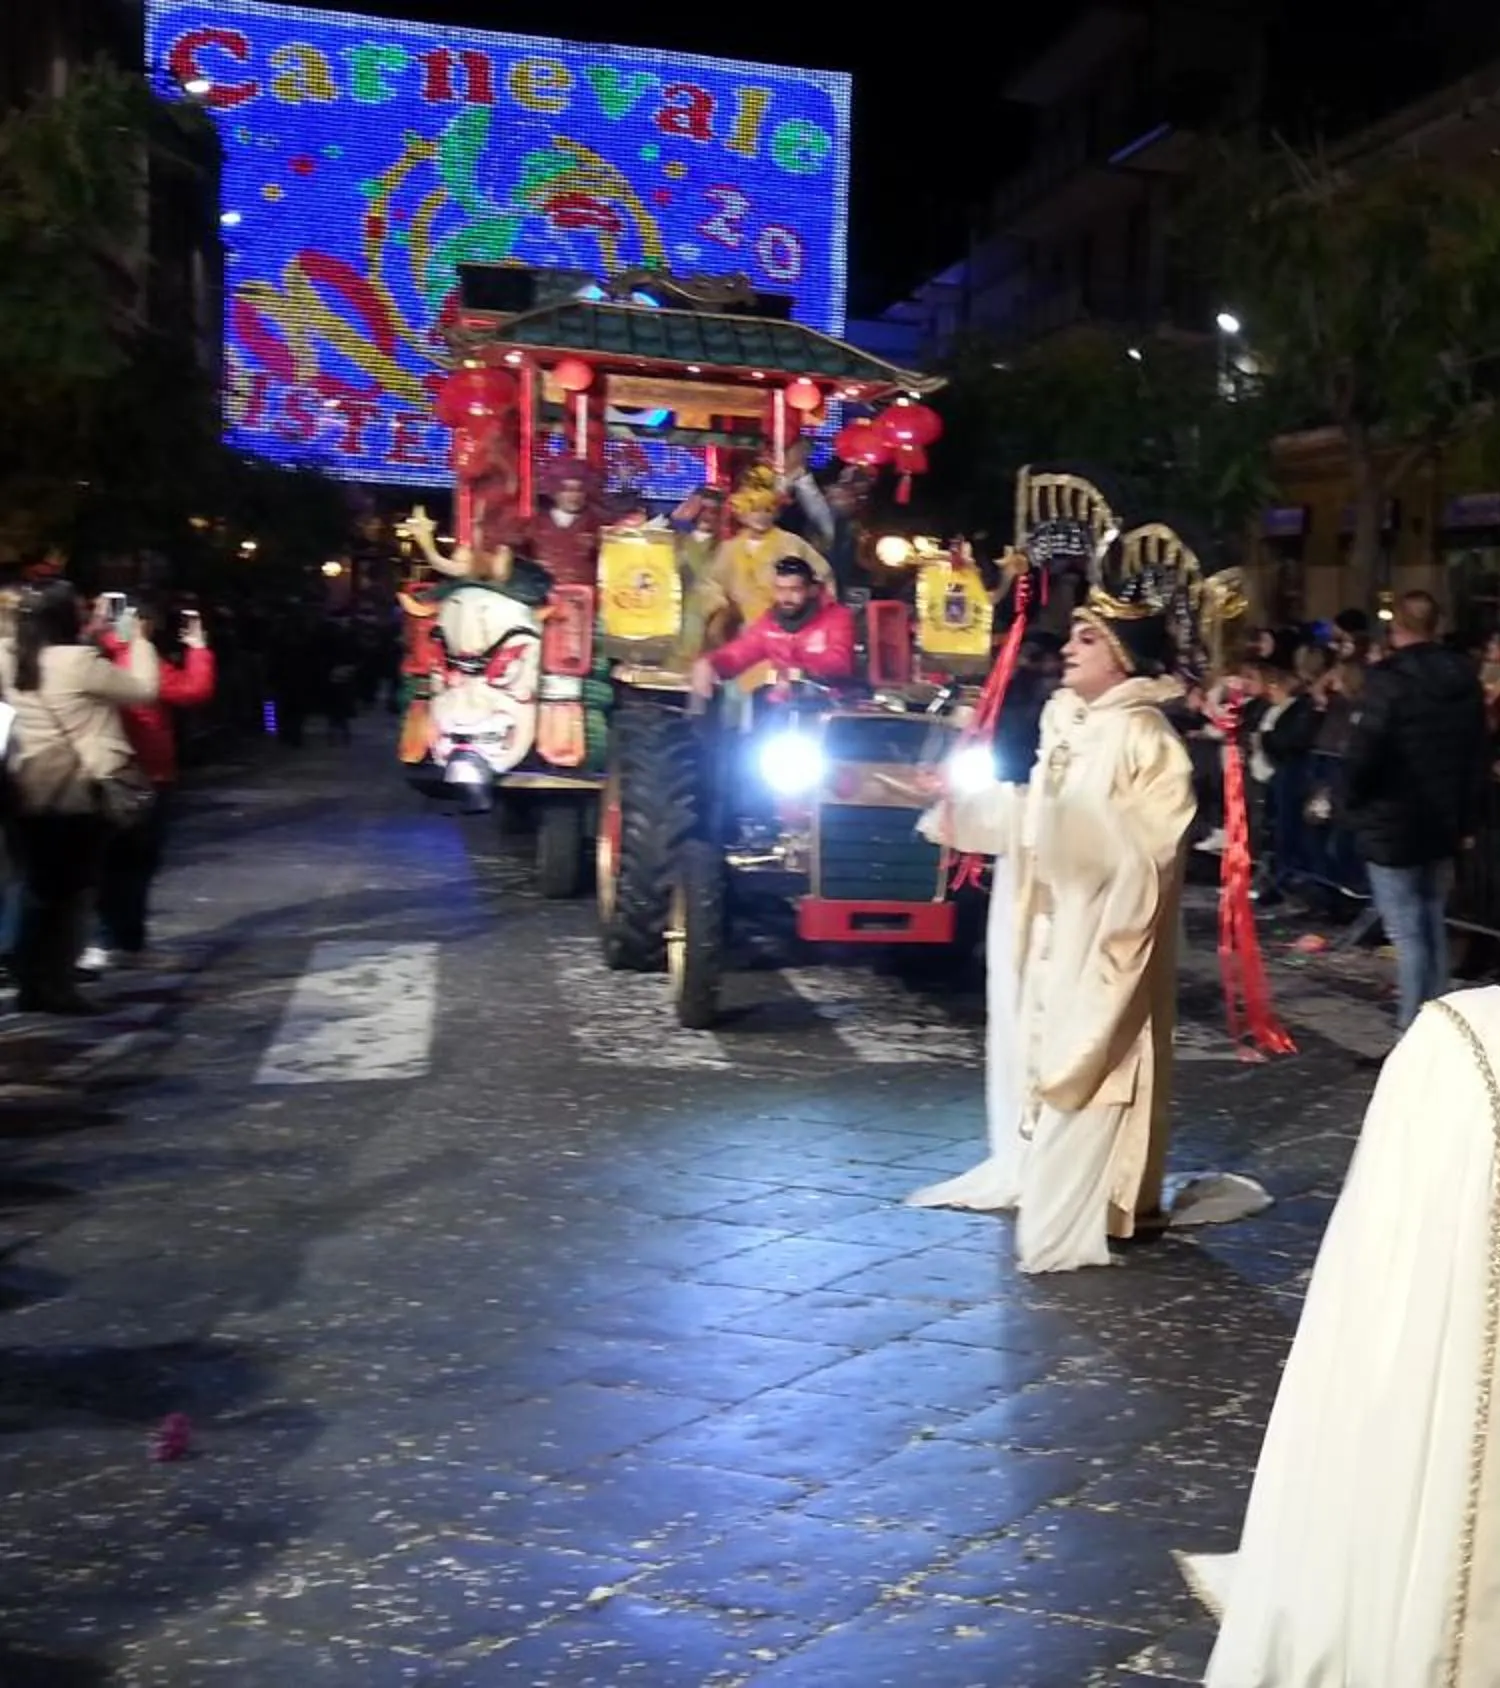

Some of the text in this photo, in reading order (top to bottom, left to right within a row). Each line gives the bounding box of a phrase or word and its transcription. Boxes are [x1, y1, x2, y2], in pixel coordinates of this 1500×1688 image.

[168, 27, 833, 174] Carnevale
[697, 184, 805, 282] 20
[236, 372, 454, 465] ISTE
